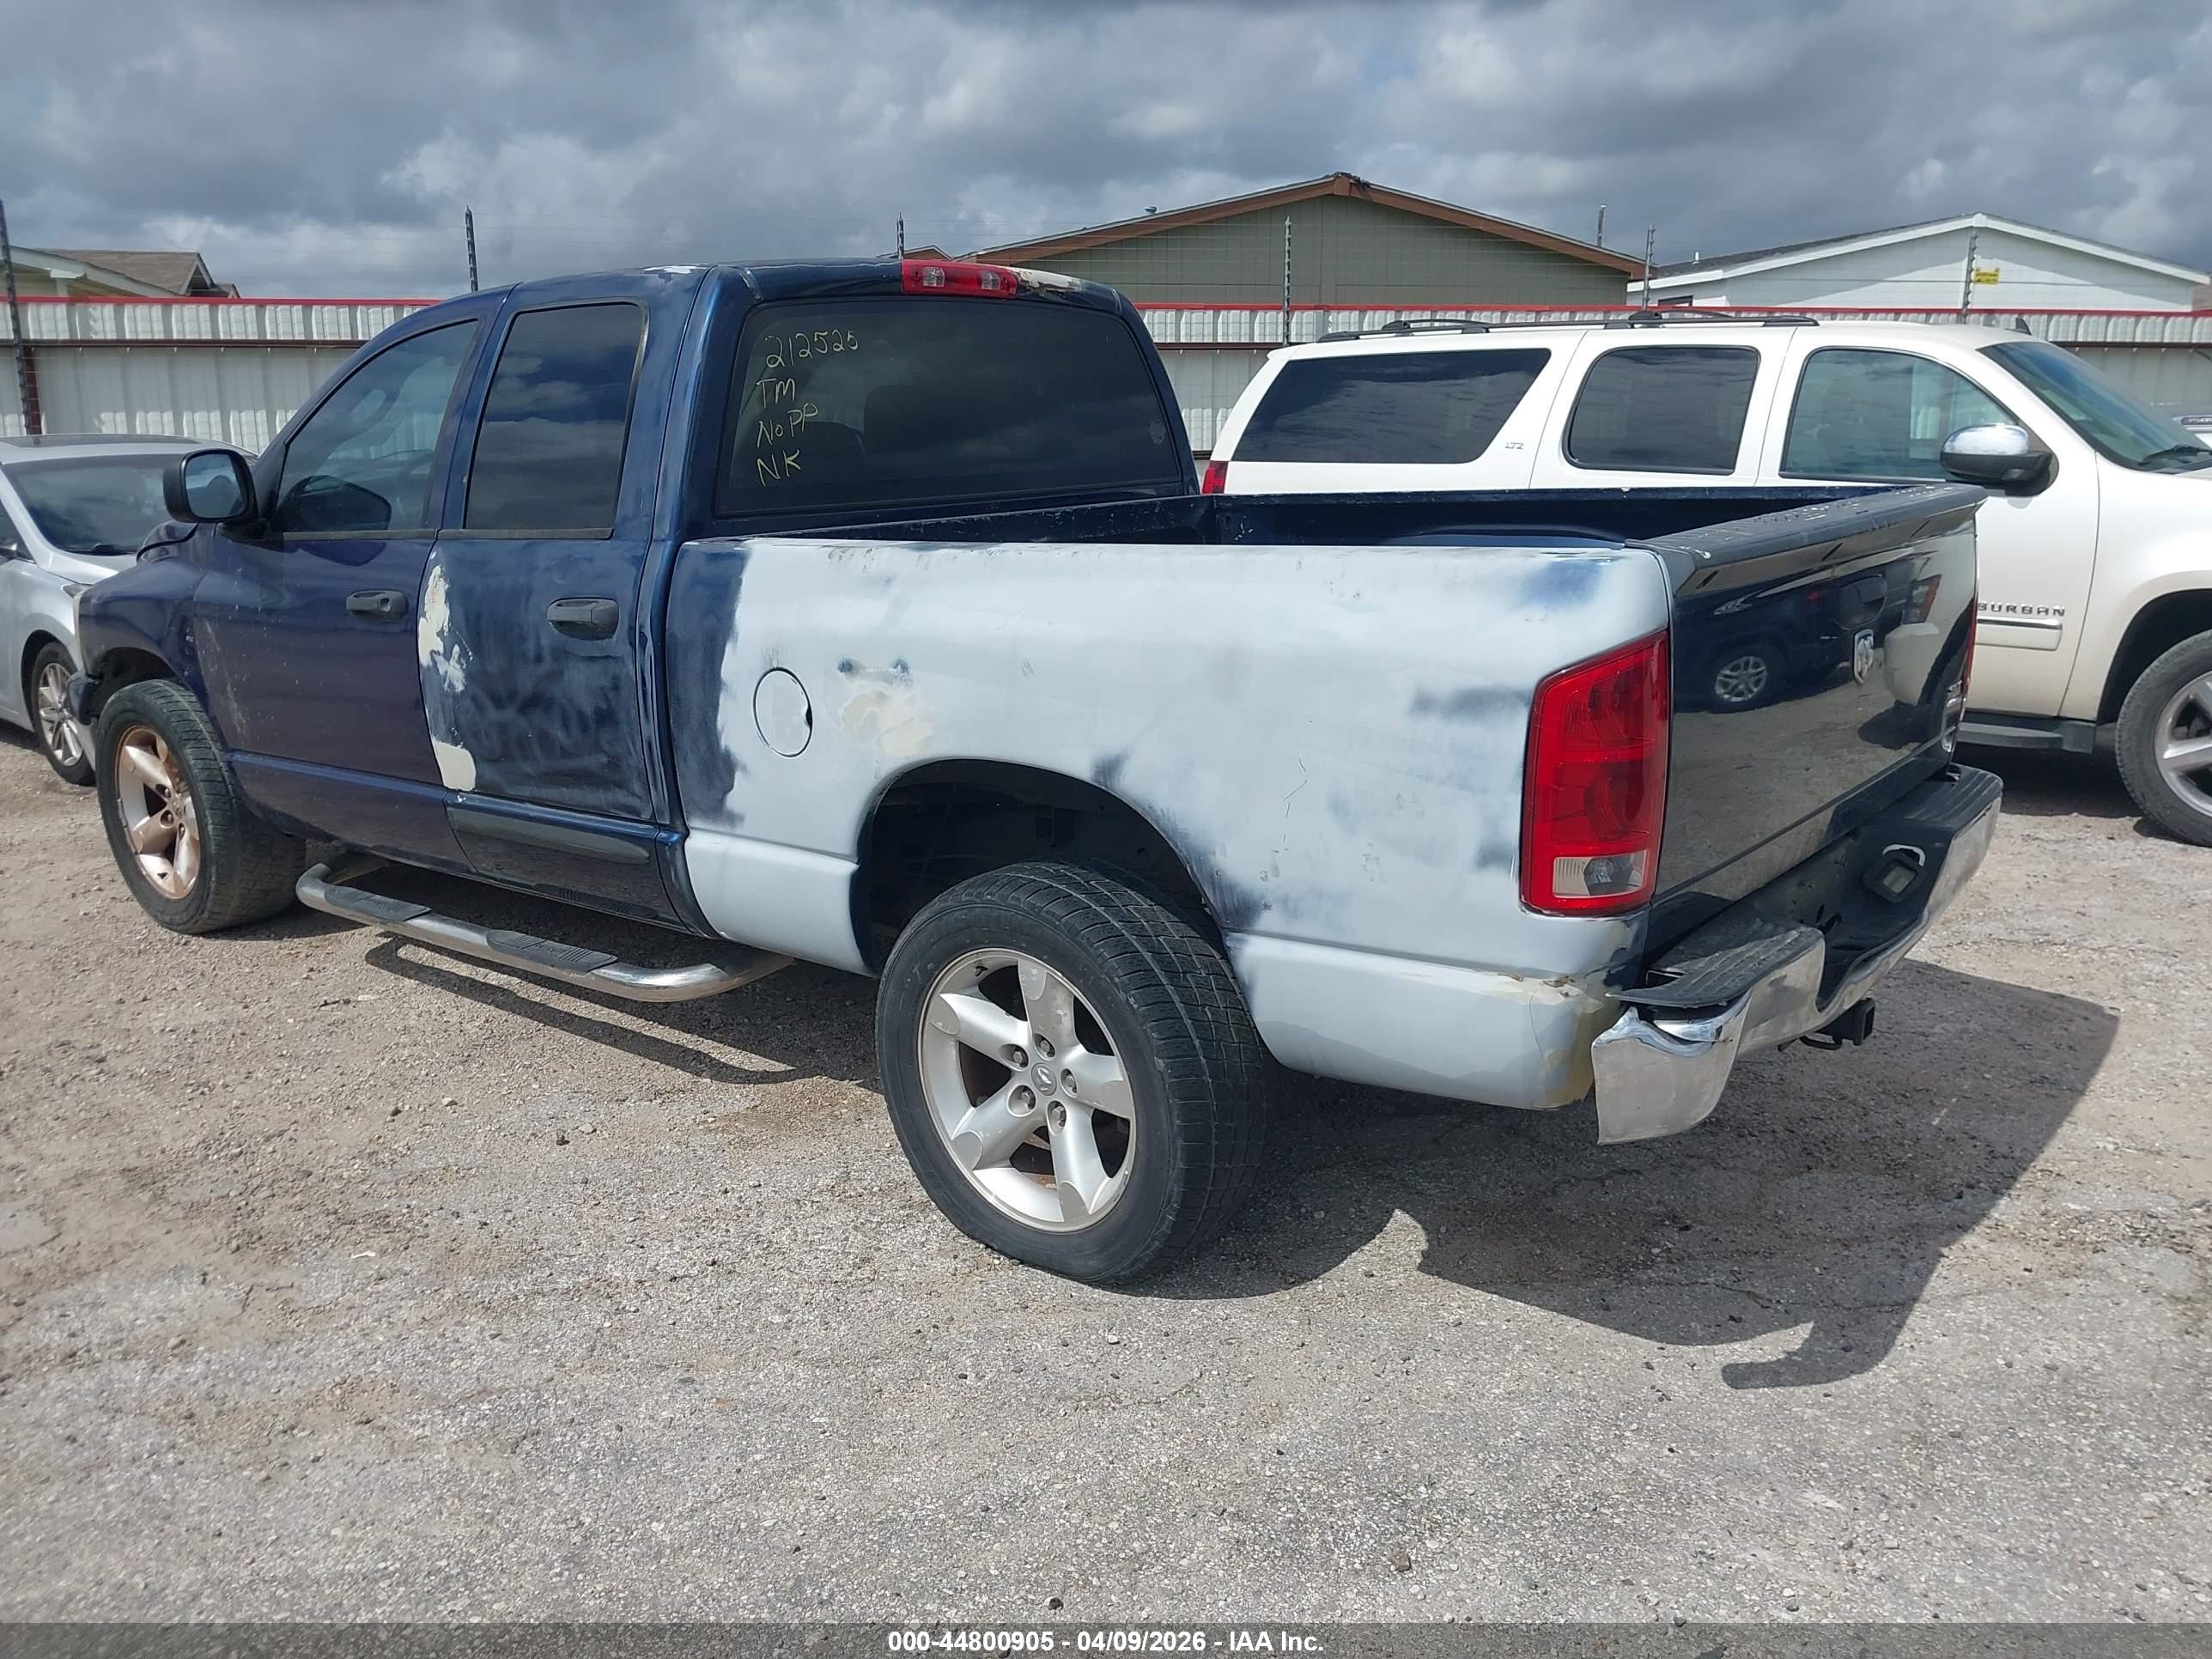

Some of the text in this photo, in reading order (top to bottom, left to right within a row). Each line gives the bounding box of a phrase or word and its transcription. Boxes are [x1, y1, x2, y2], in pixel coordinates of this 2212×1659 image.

[763, 329, 859, 368] 212525
[756, 378, 796, 409] TM
[1504, 441, 1525, 450] LTZ
[757, 448, 802, 487] NK
